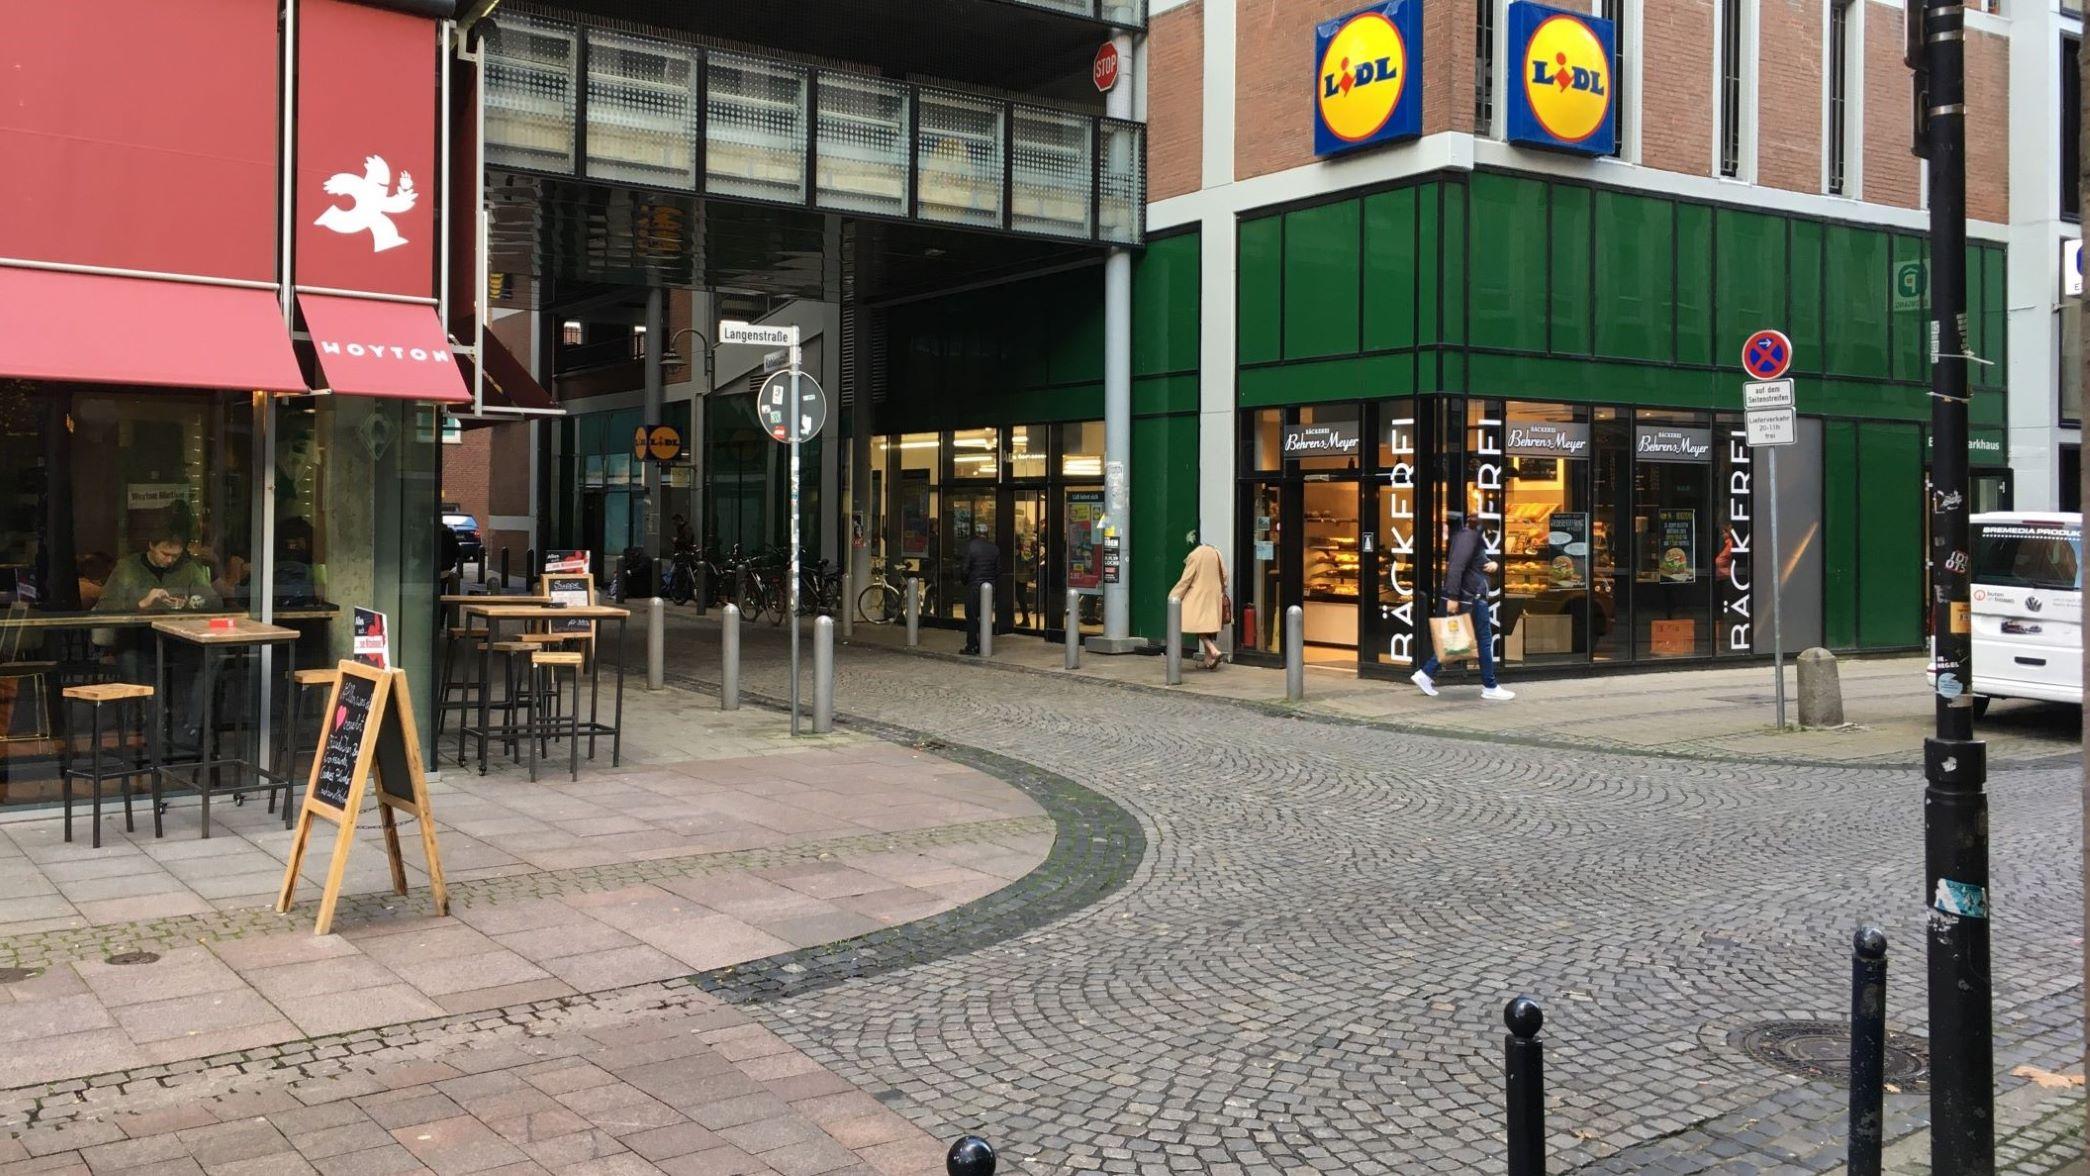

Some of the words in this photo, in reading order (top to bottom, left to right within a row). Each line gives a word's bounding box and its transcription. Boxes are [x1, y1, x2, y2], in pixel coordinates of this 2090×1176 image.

[1096, 54, 1117, 78] STOP
[724, 327, 789, 343] Langenstraße
[1748, 394, 1789, 403] Seitenstreifen
[1749, 415, 1790, 424] Lieferverkehr
[1968, 439, 2000, 450] arkhaus
[1982, 526, 2035, 534] BREMEDIA
